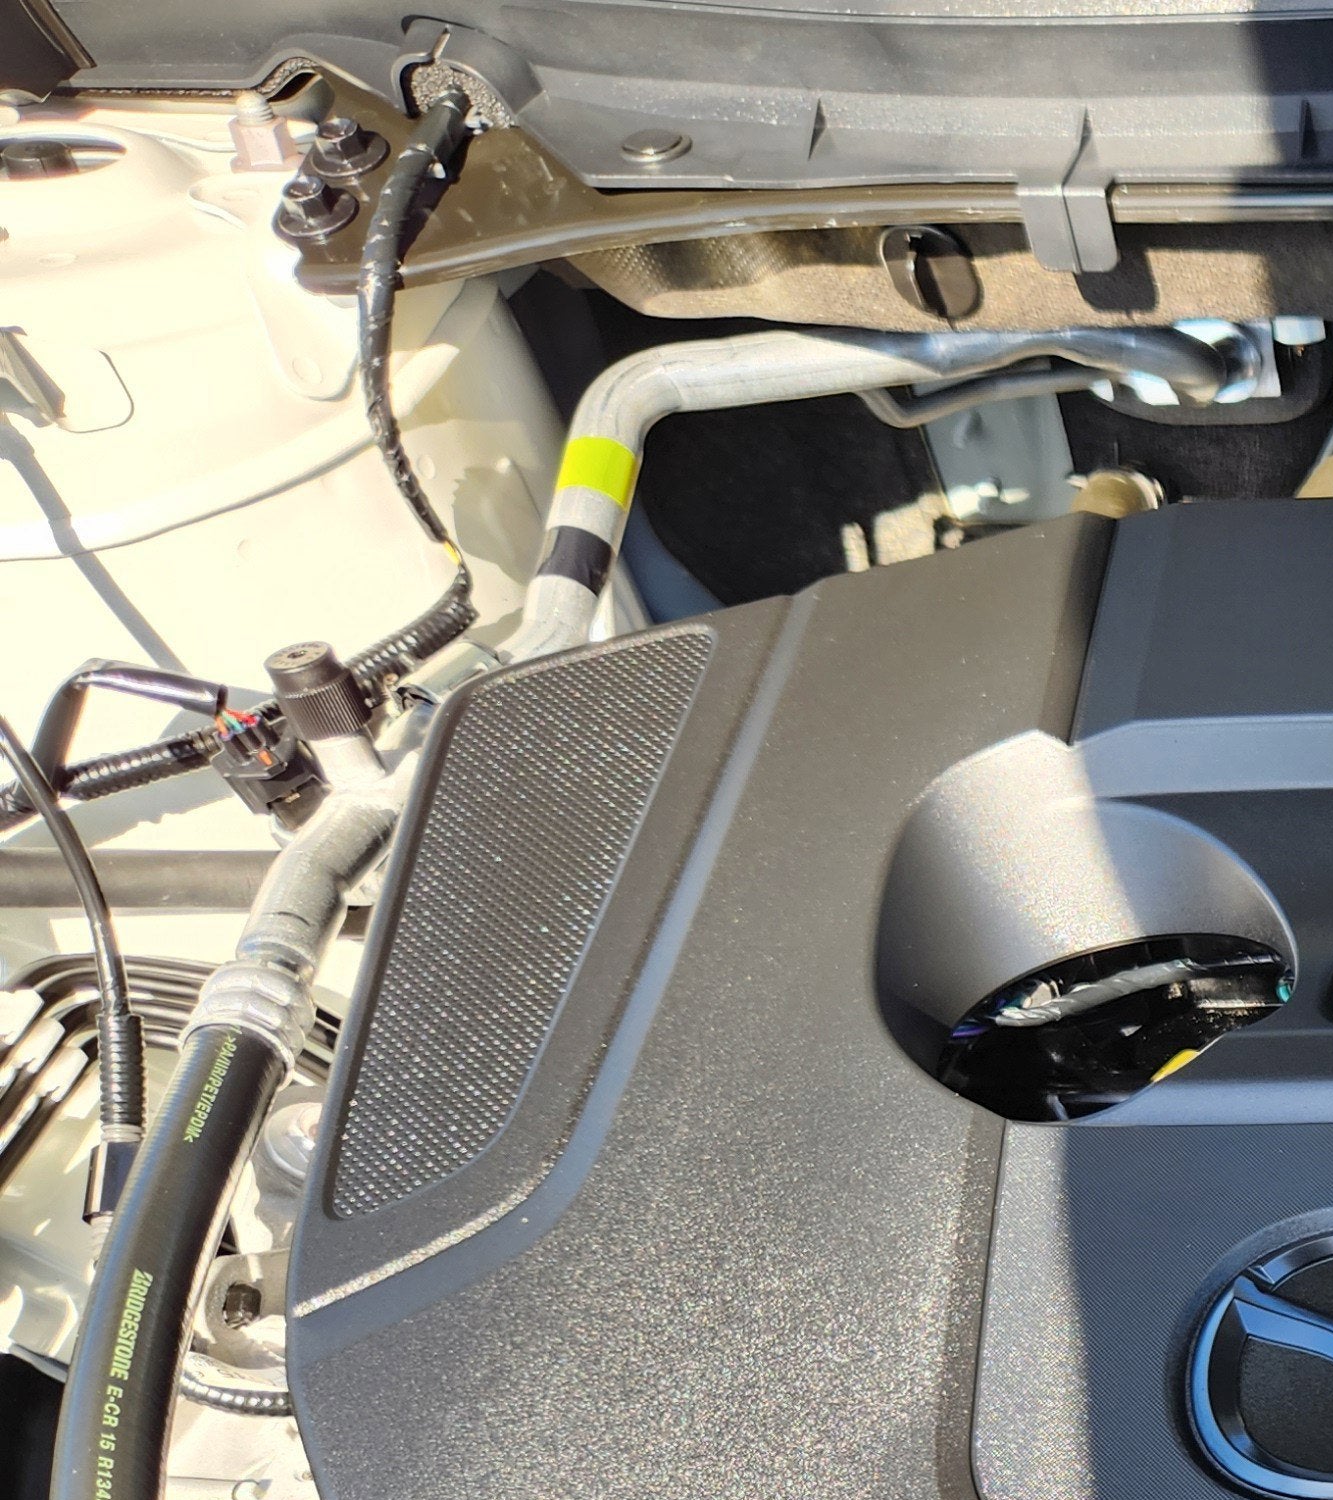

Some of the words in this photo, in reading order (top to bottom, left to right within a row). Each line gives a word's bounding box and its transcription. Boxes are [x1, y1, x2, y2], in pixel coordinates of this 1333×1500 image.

[108, 1267, 154, 1382] BRIDGESTONE
[101, 1384, 124, 1428] E-CR
[98, 1431, 117, 1452] 15
